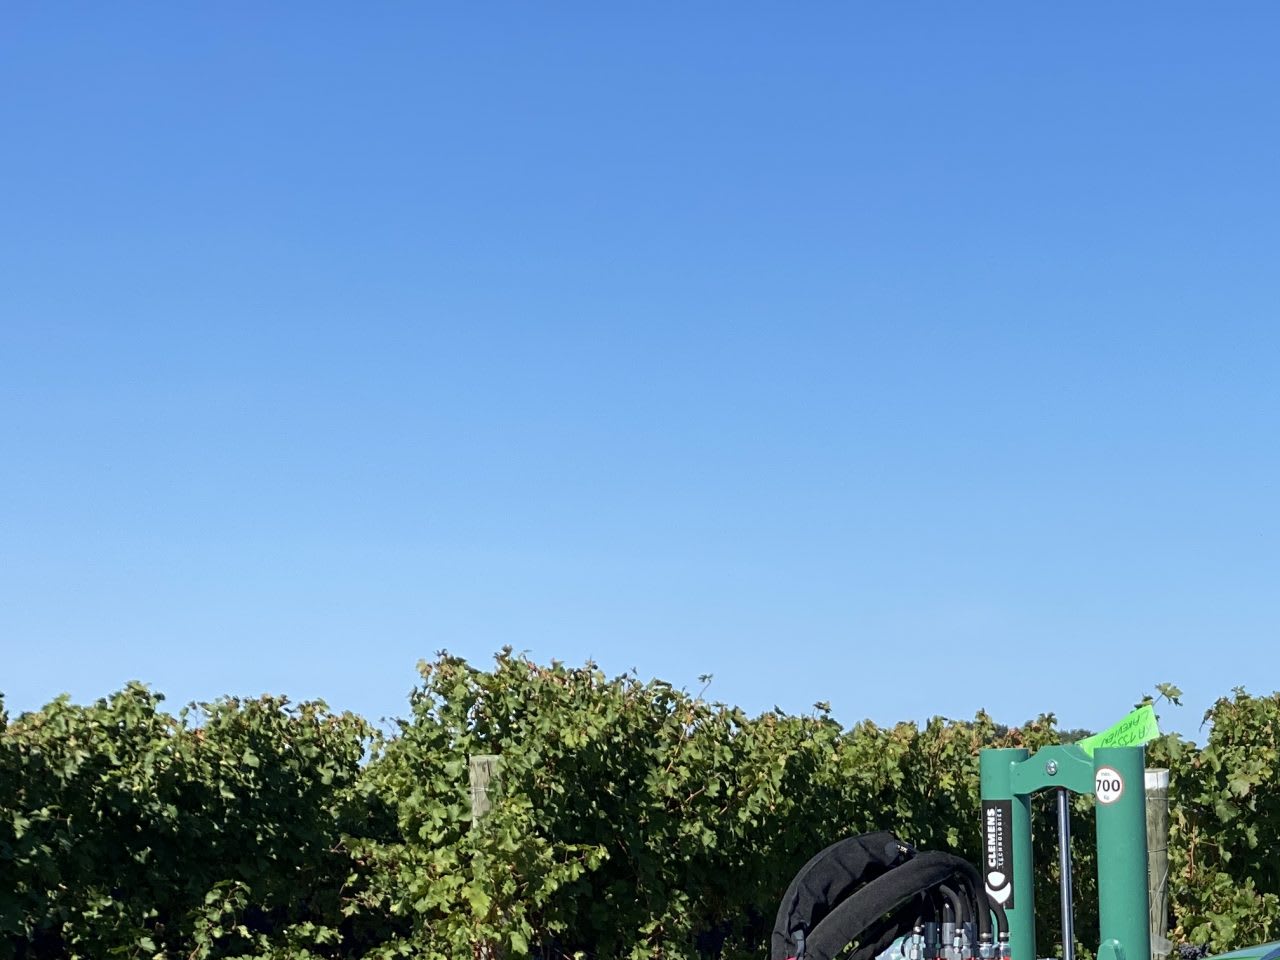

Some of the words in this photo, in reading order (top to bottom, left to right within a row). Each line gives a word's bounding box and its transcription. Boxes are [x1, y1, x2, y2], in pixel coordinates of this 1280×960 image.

[1096, 779, 1120, 792] 700
[987, 808, 996, 868] CLEMENS
[996, 808, 1004, 867] TECHNOLOGIES
